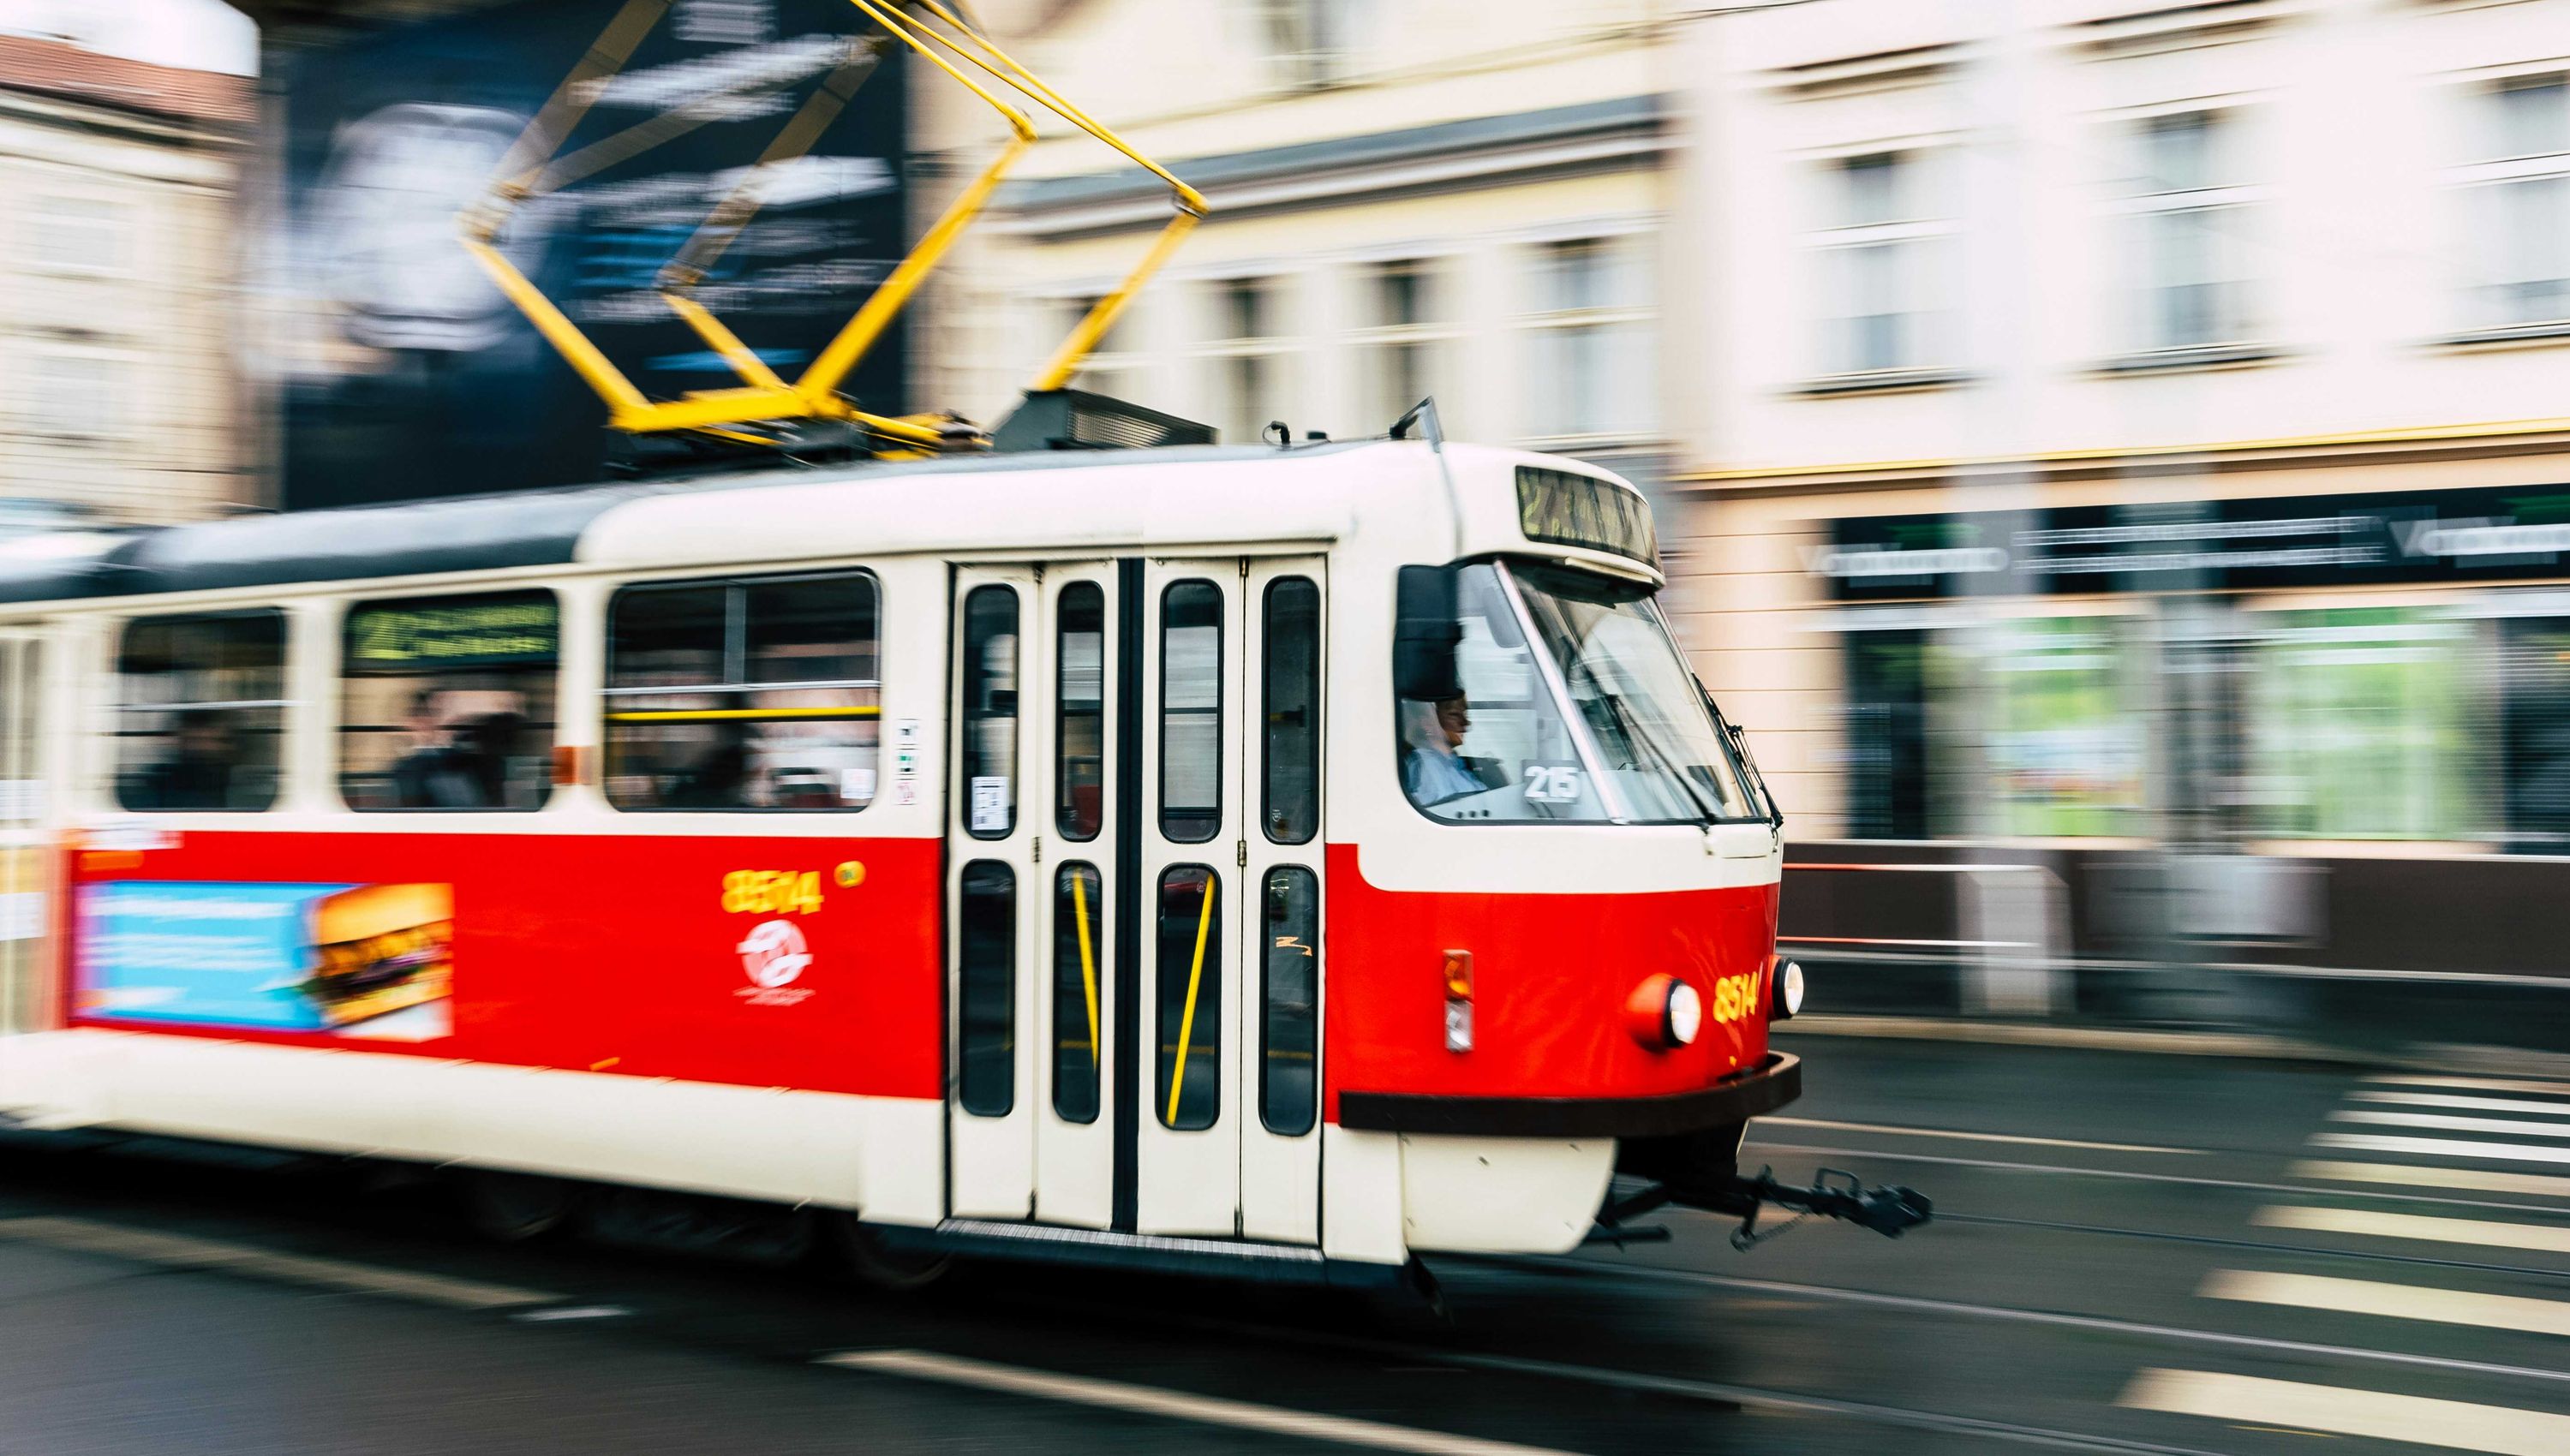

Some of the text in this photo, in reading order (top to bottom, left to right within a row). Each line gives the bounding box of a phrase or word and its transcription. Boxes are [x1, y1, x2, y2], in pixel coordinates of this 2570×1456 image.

[1524, 766, 1581, 797] 215
[720, 869, 825, 916] 8514
[1712, 971, 1758, 1024] 8514
